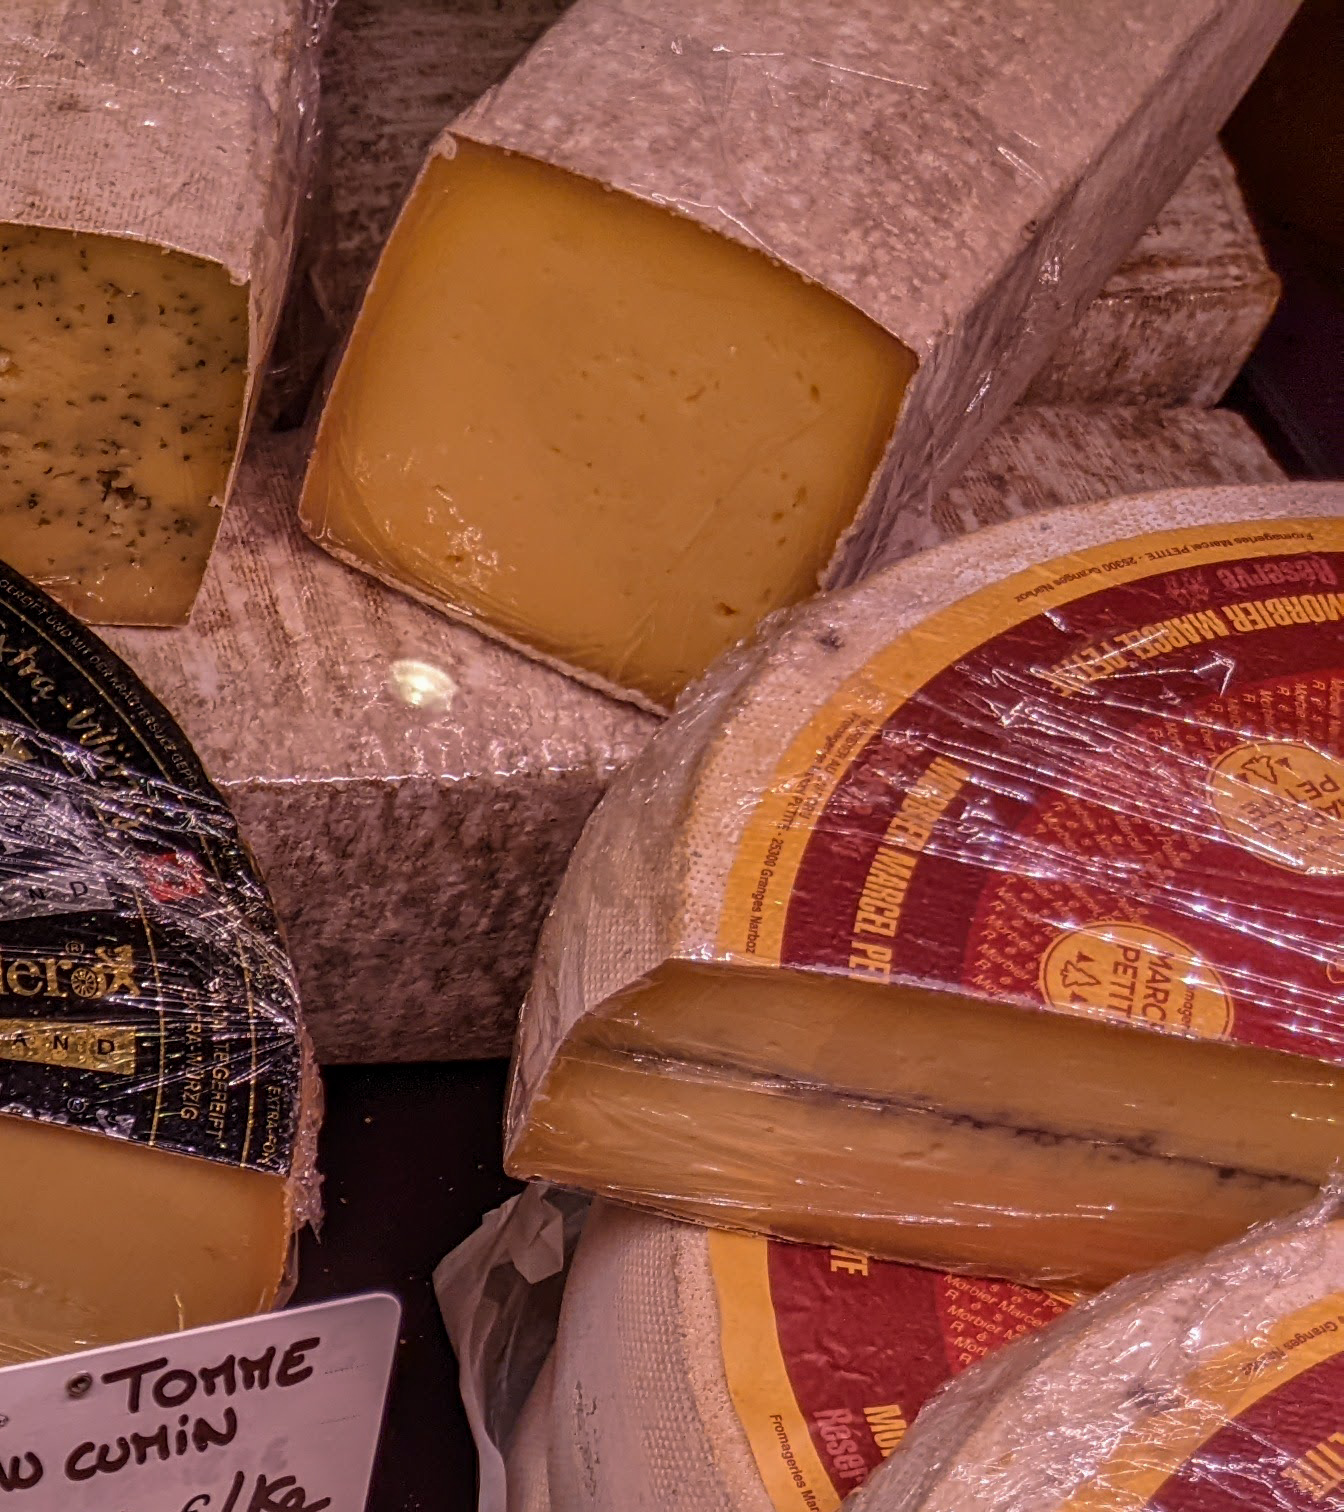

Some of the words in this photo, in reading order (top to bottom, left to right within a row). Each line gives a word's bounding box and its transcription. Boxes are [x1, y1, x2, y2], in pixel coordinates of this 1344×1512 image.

[854, 848, 917, 937] MARCEL
[101, 1336, 321, 1414] TOMME
[769, 1414, 807, 1489] Fromageries
